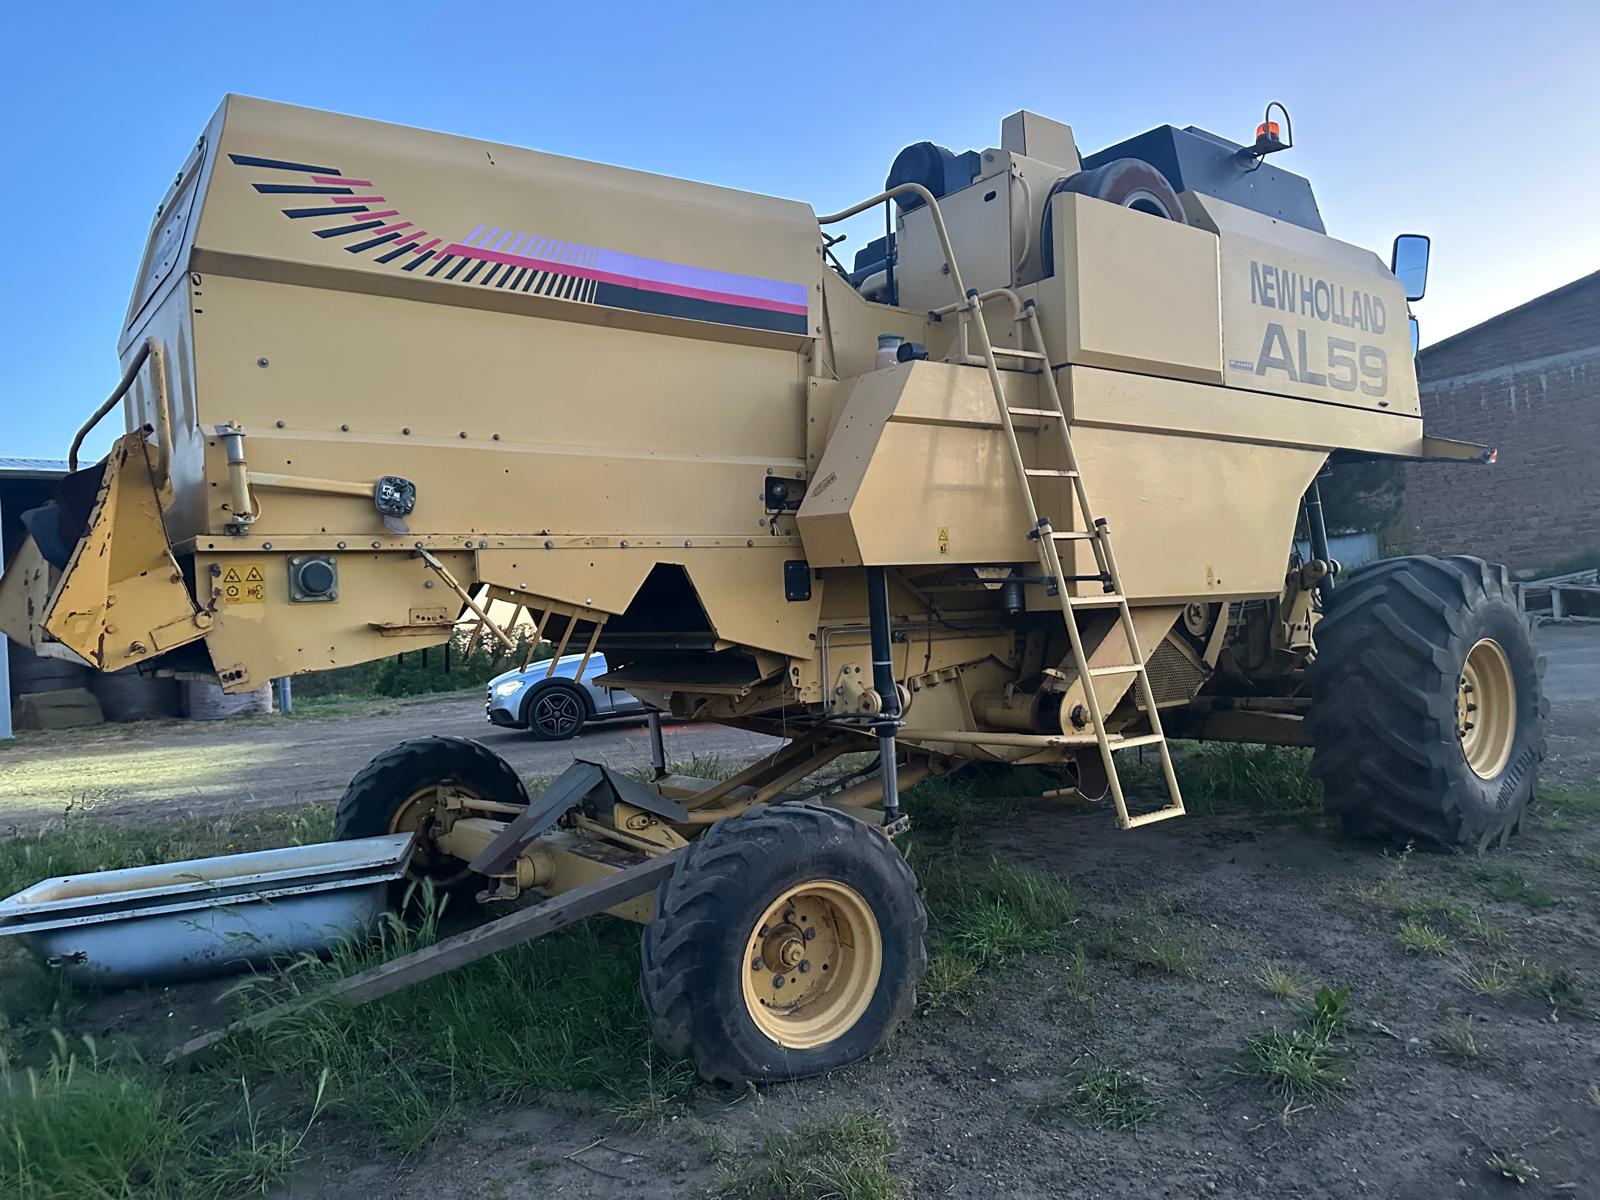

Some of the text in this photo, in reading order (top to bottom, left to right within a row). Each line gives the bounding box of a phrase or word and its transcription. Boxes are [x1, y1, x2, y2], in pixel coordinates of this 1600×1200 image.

[1250, 260, 1386, 335] NEW HOLLAND
[1255, 321, 1388, 397] AL59
